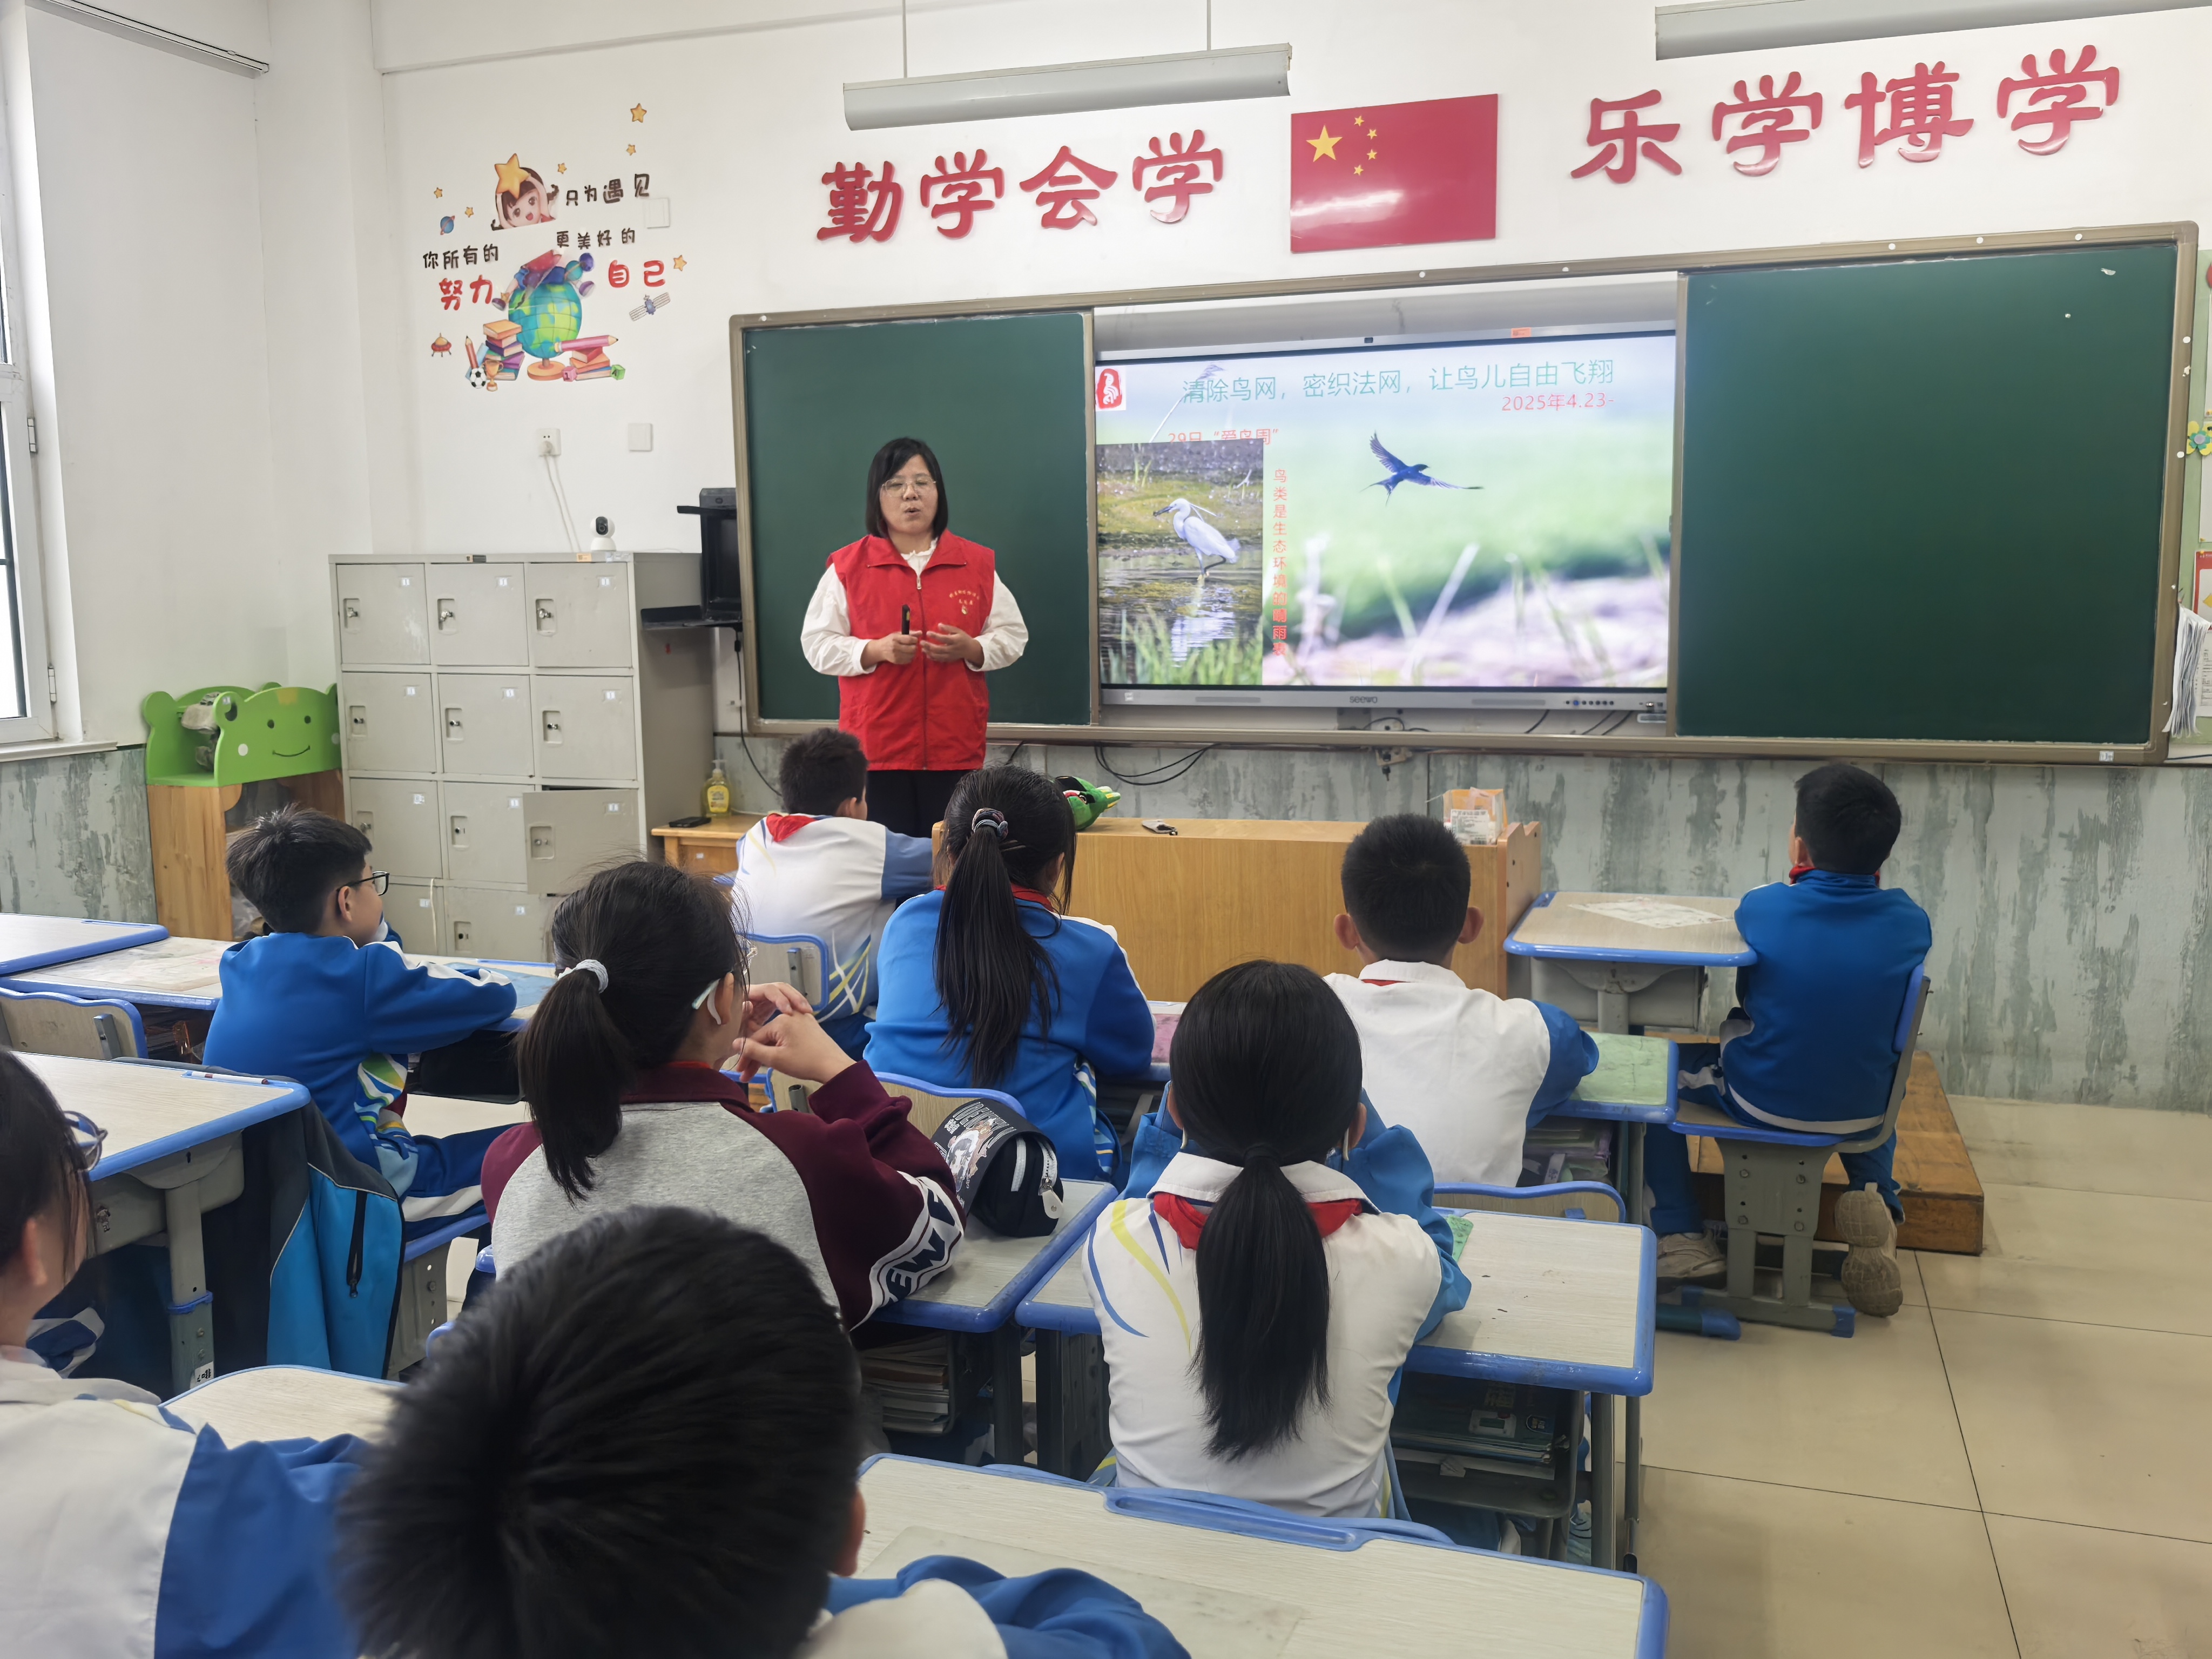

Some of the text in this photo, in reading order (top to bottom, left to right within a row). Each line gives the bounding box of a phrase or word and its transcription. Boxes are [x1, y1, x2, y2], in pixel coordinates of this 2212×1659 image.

[1570, 44, 2120, 184] 乐学博学
[566, 173, 650, 206] 只为遇见
[817, 129, 1224, 242] 勤学会学
[556, 227, 636, 250] 更美好的
[423, 244, 499, 269] 你所有的
[608, 260, 665, 288] 自己
[439, 274, 493, 311] 努力
